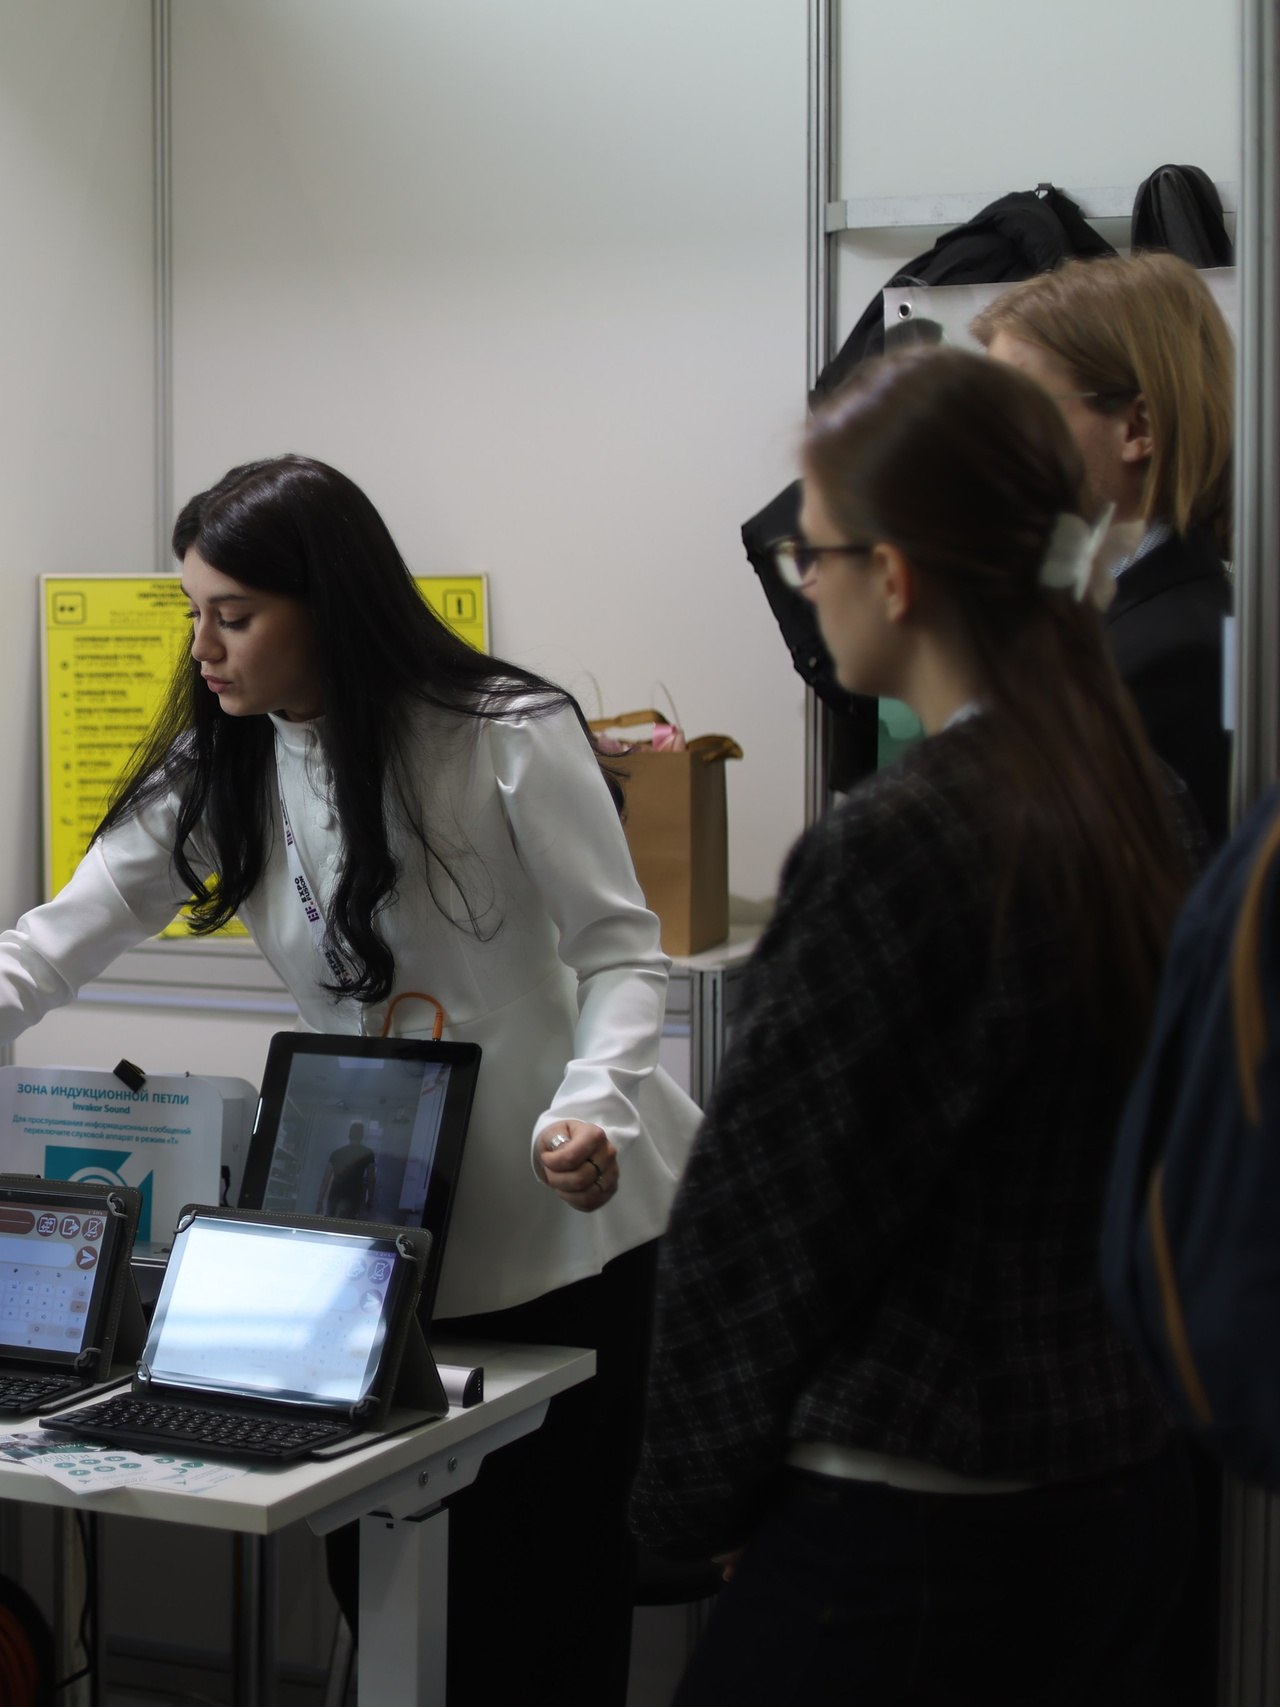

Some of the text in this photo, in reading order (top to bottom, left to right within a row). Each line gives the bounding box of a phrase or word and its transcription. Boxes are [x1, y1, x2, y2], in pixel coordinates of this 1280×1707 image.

[295, 878, 307, 903] EXPO
[299, 876, 311, 901] FUSION
[17, 1083, 189, 1105] ЗОНА ИНДУКЦИОННОЙ ПЕТЛИ
[72, 1102, 130, 1114] Invakor Sound
[12, 1114, 191, 1135] Для прослушивания информационных сообщений
[24, 1127, 70, 1136] переключите
[71, 1131, 104, 1139] слуховой
[105, 1134, 133, 1142] аппарат
[141, 1136, 165, 1144] режим
